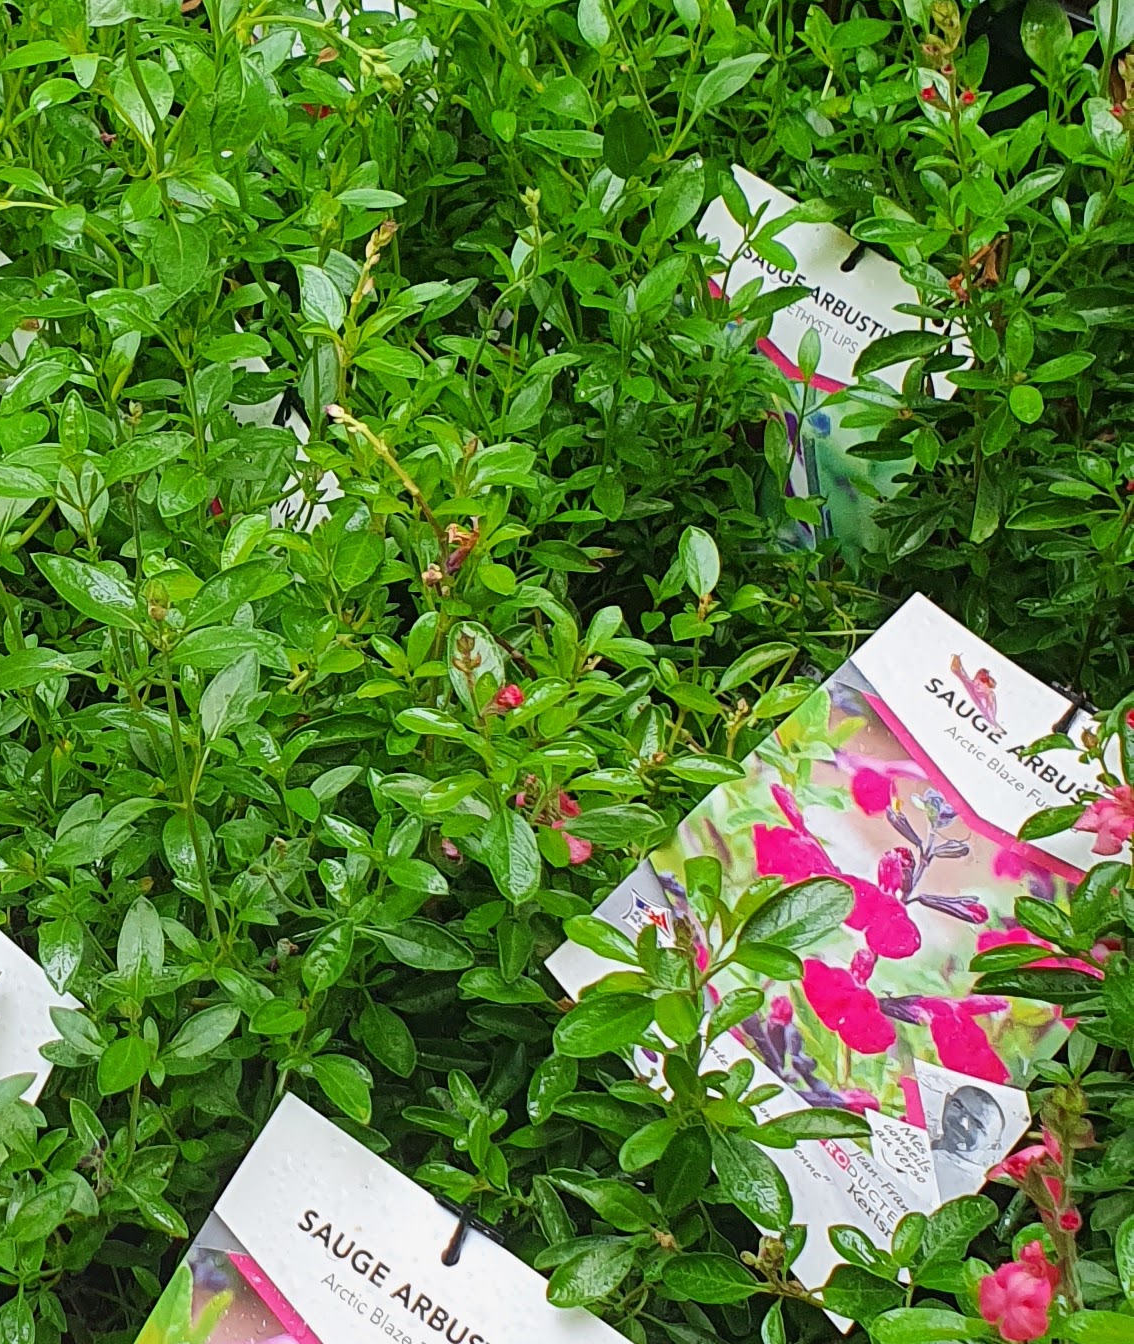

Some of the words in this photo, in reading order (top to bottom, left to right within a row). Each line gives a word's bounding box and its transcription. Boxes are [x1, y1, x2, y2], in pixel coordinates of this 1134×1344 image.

[809, 285, 890, 339] ARBUSTI
[831, 330, 859, 355] LIPS
[924, 677, 1008, 745] SAUGE
[944, 725, 987, 762] Arctic
[986, 757, 1026, 792] Blaze
[875, 1129, 893, 1148] au
[893, 1149, 927, 1184] verso
[883, 1124, 931, 1174] conseils
[900, 1127, 927, 1155] Mes
[822, 1138, 898, 1224] RODUCTE
[848, 1150, 909, 1213] Jean-Fran
[297, 1209, 391, 1289] SAUGE
[320, 1272, 369, 1316] Arctic
